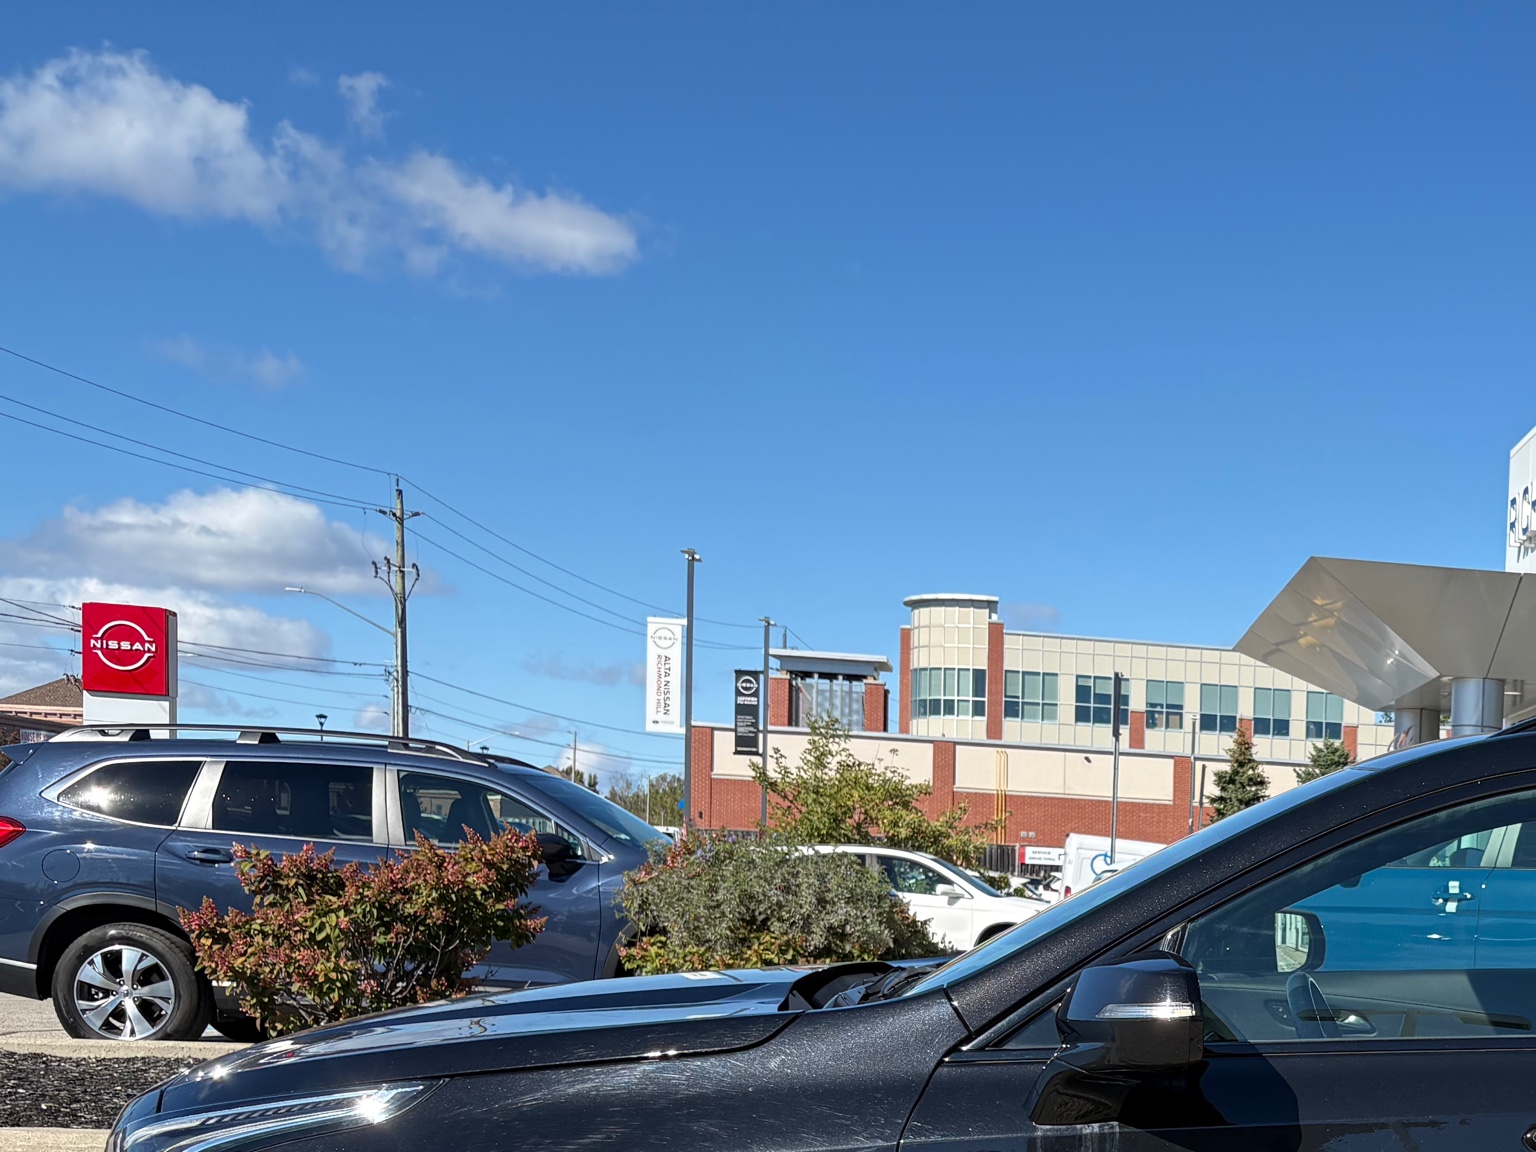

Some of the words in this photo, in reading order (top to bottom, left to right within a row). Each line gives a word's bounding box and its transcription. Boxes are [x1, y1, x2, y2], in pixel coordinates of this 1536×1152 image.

[90, 638, 156, 652] NISSAN
[651, 634, 678, 642] NISSAN
[663, 655, 671, 678] ALTA
[663, 680, 671, 716] NISSAN
